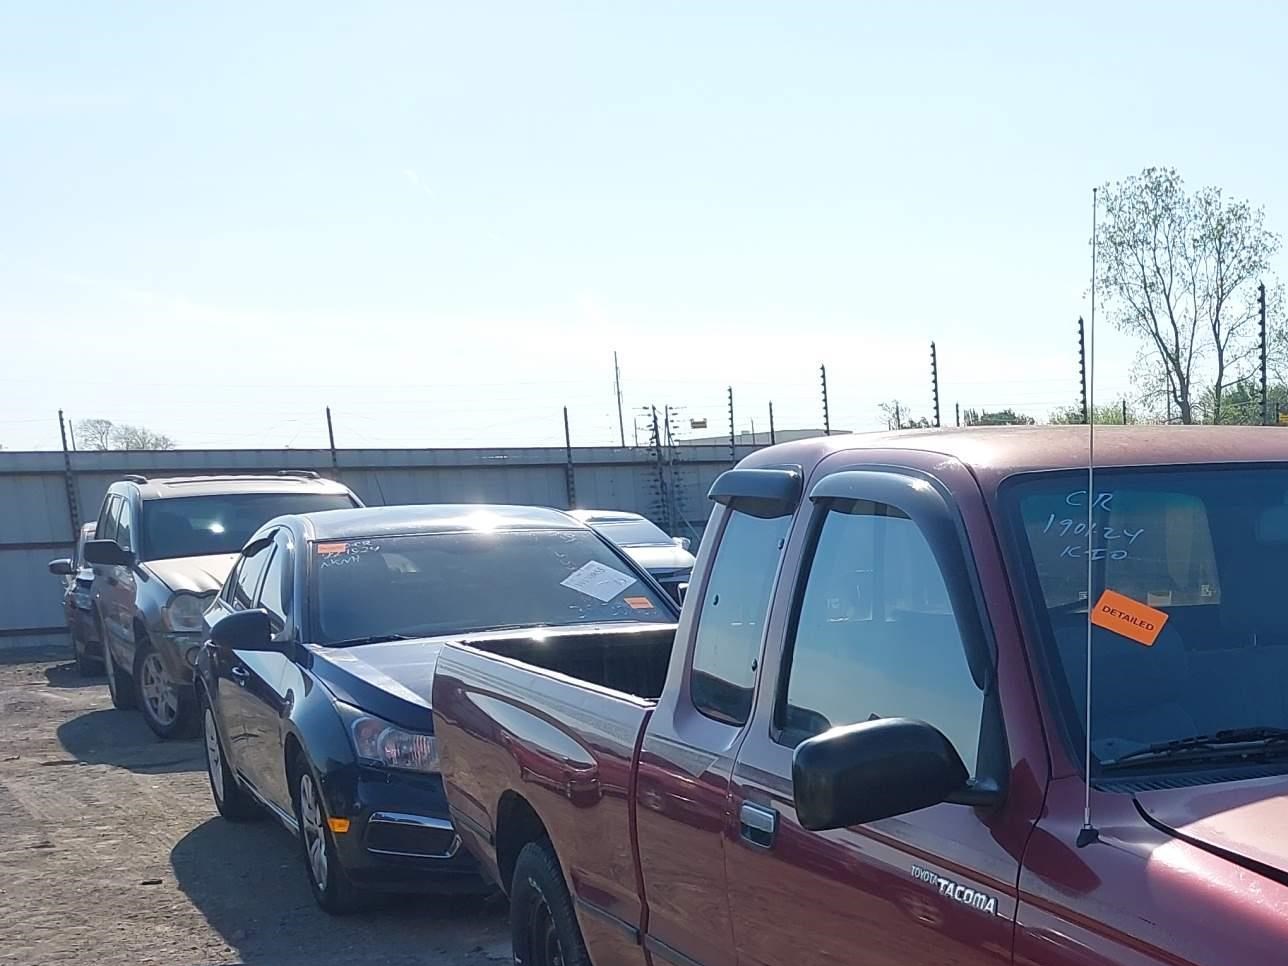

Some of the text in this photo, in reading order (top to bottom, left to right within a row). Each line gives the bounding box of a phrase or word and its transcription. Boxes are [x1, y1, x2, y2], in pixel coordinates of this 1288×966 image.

[1101, 605, 1154, 631] DETAILED
[911, 864, 996, 914] TOYOTA TACOMA
